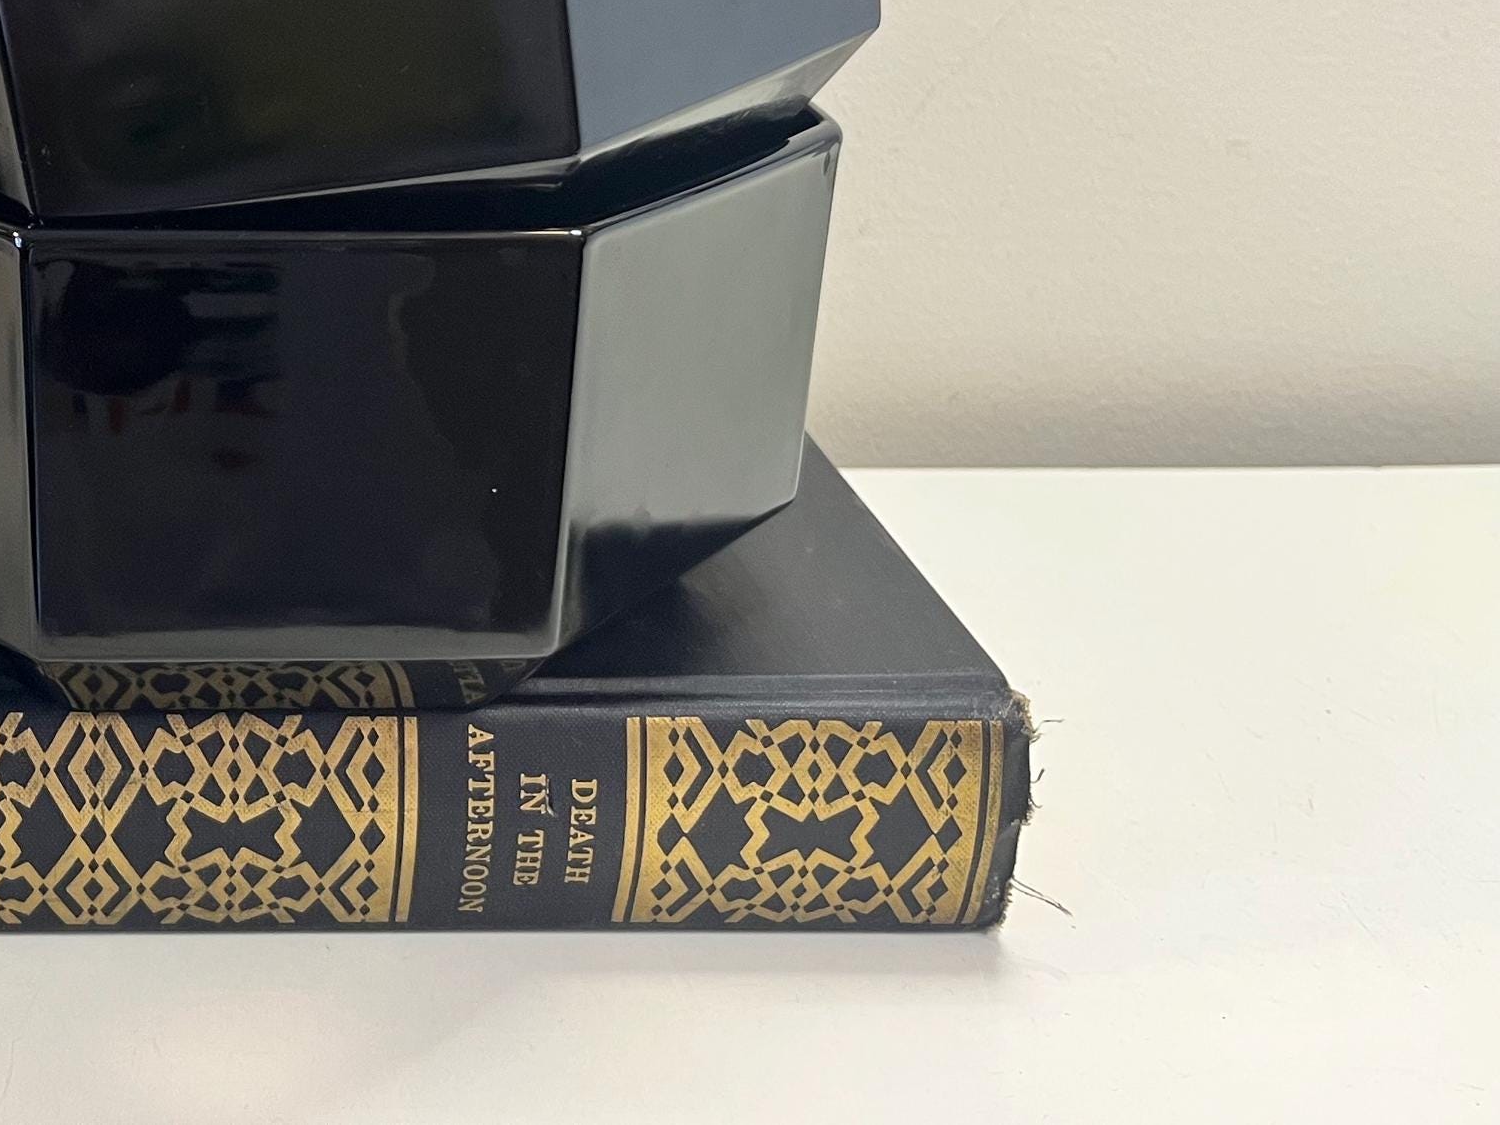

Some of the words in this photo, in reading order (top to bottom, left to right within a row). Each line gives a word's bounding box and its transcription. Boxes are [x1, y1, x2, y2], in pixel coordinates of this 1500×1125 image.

[457, 724, 495, 913] AFTERNOON
[519, 773, 549, 815] IN
[564, 778, 598, 884] DEATH
[513, 830, 545, 887] THE
